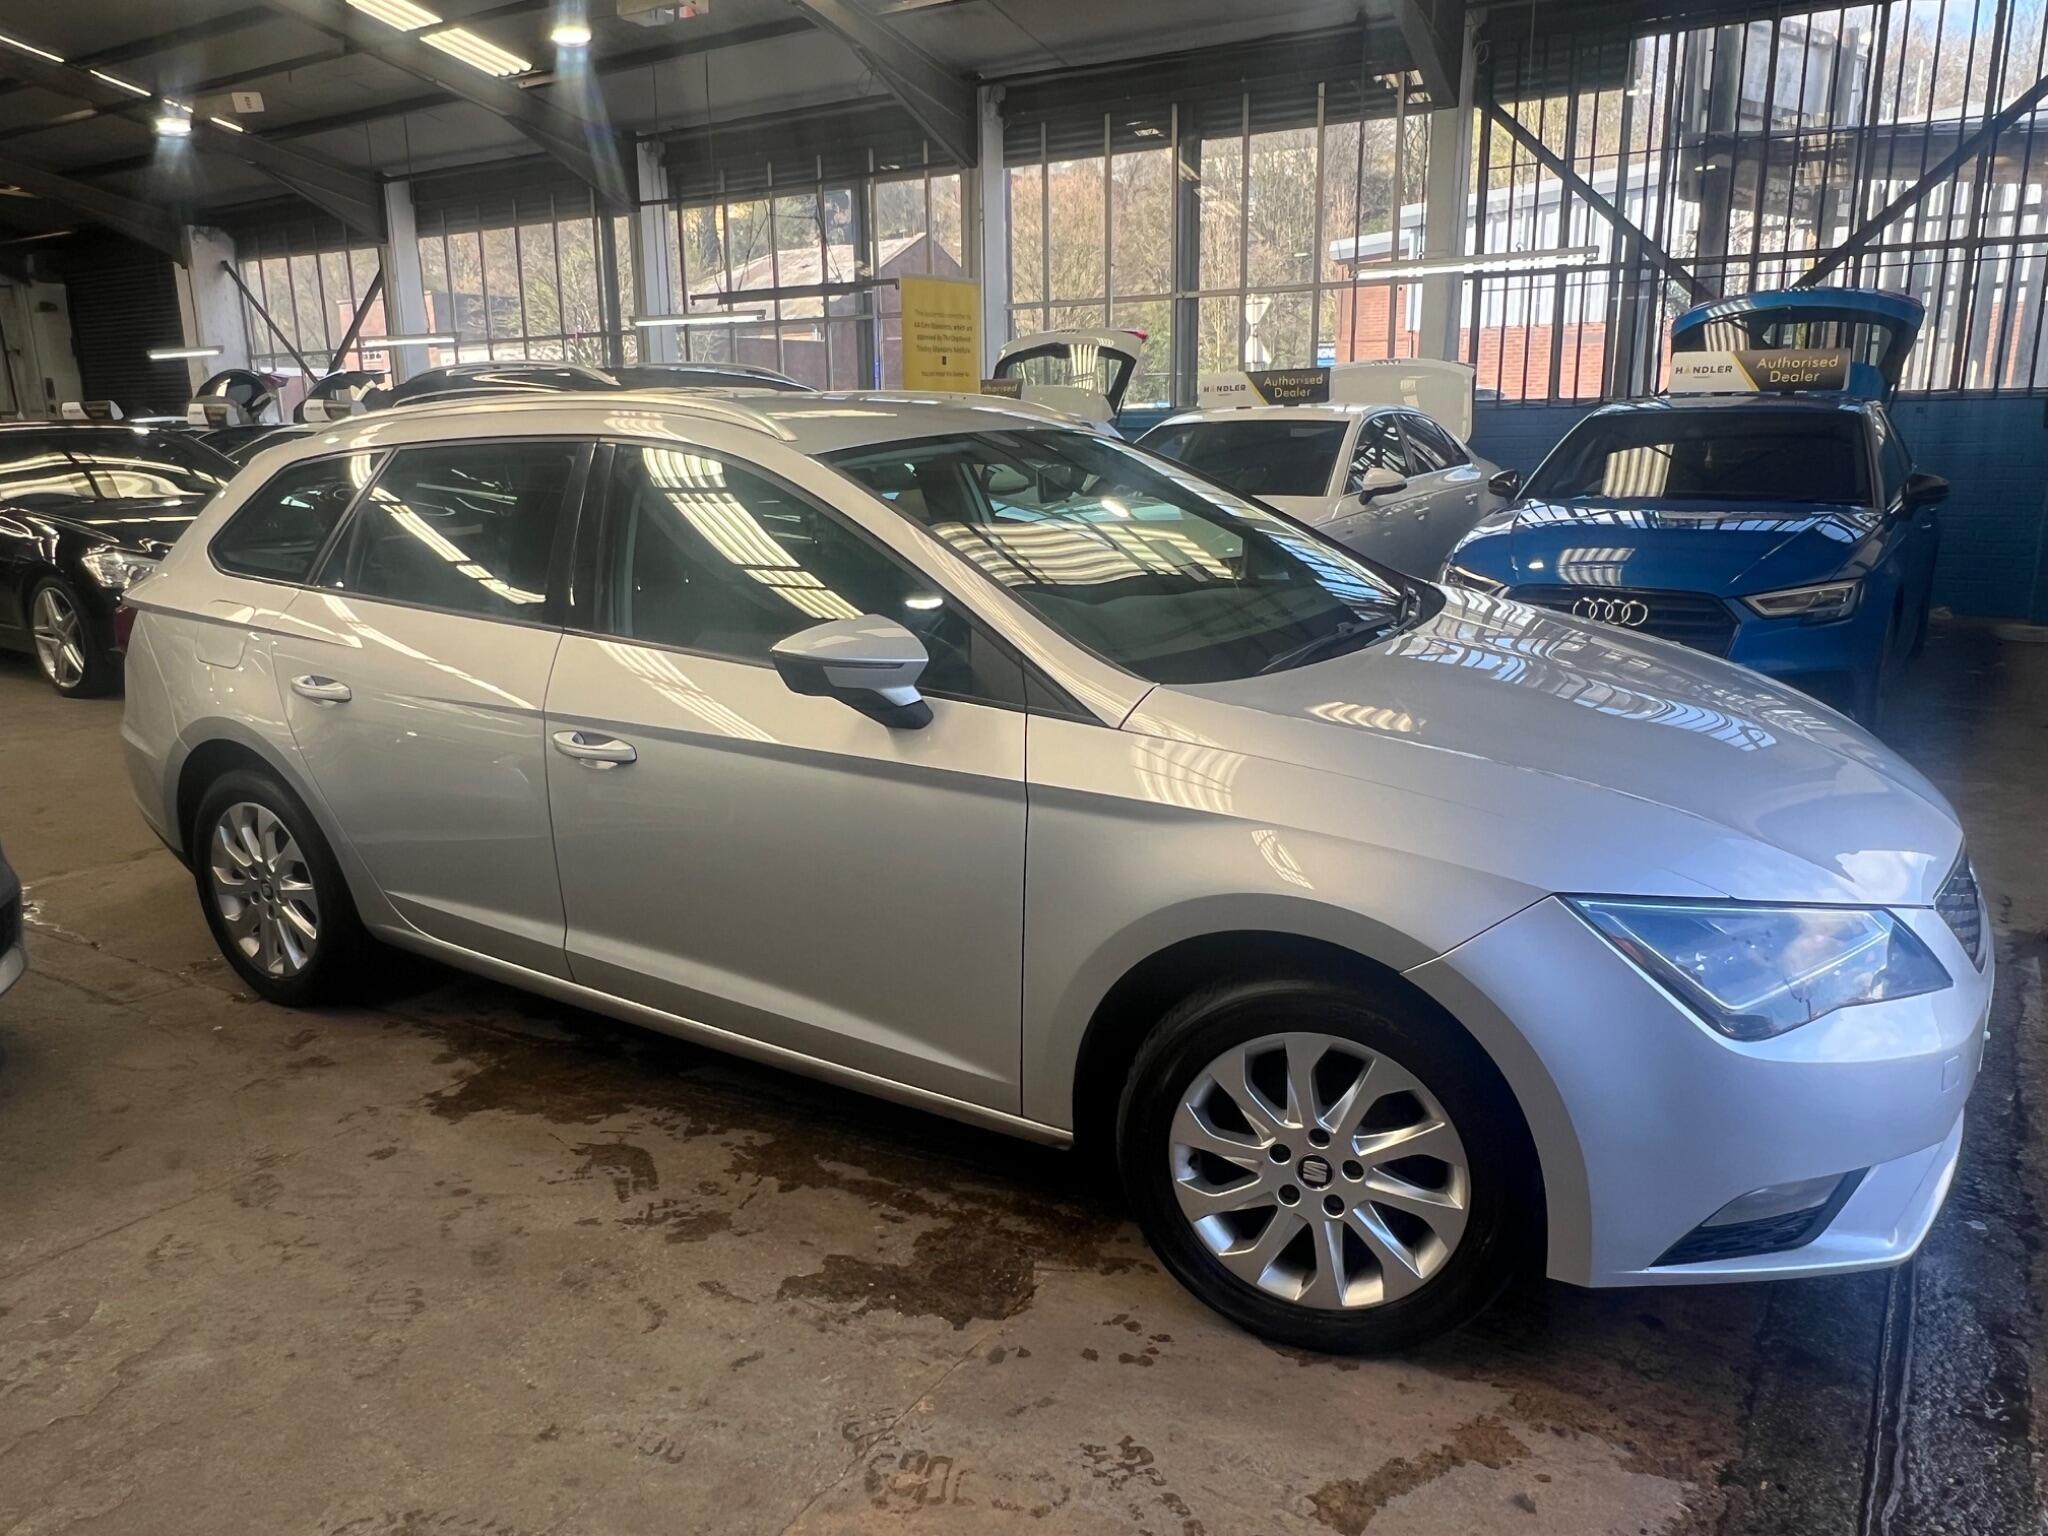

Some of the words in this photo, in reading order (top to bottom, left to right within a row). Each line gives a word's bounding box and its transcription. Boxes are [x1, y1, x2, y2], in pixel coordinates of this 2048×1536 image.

[1756, 354, 1839, 369] Authorised
[1263, 373, 1323, 387] Authorised
[1769, 369, 1820, 383] Dealer
[1274, 386, 1311, 398] Dealer
